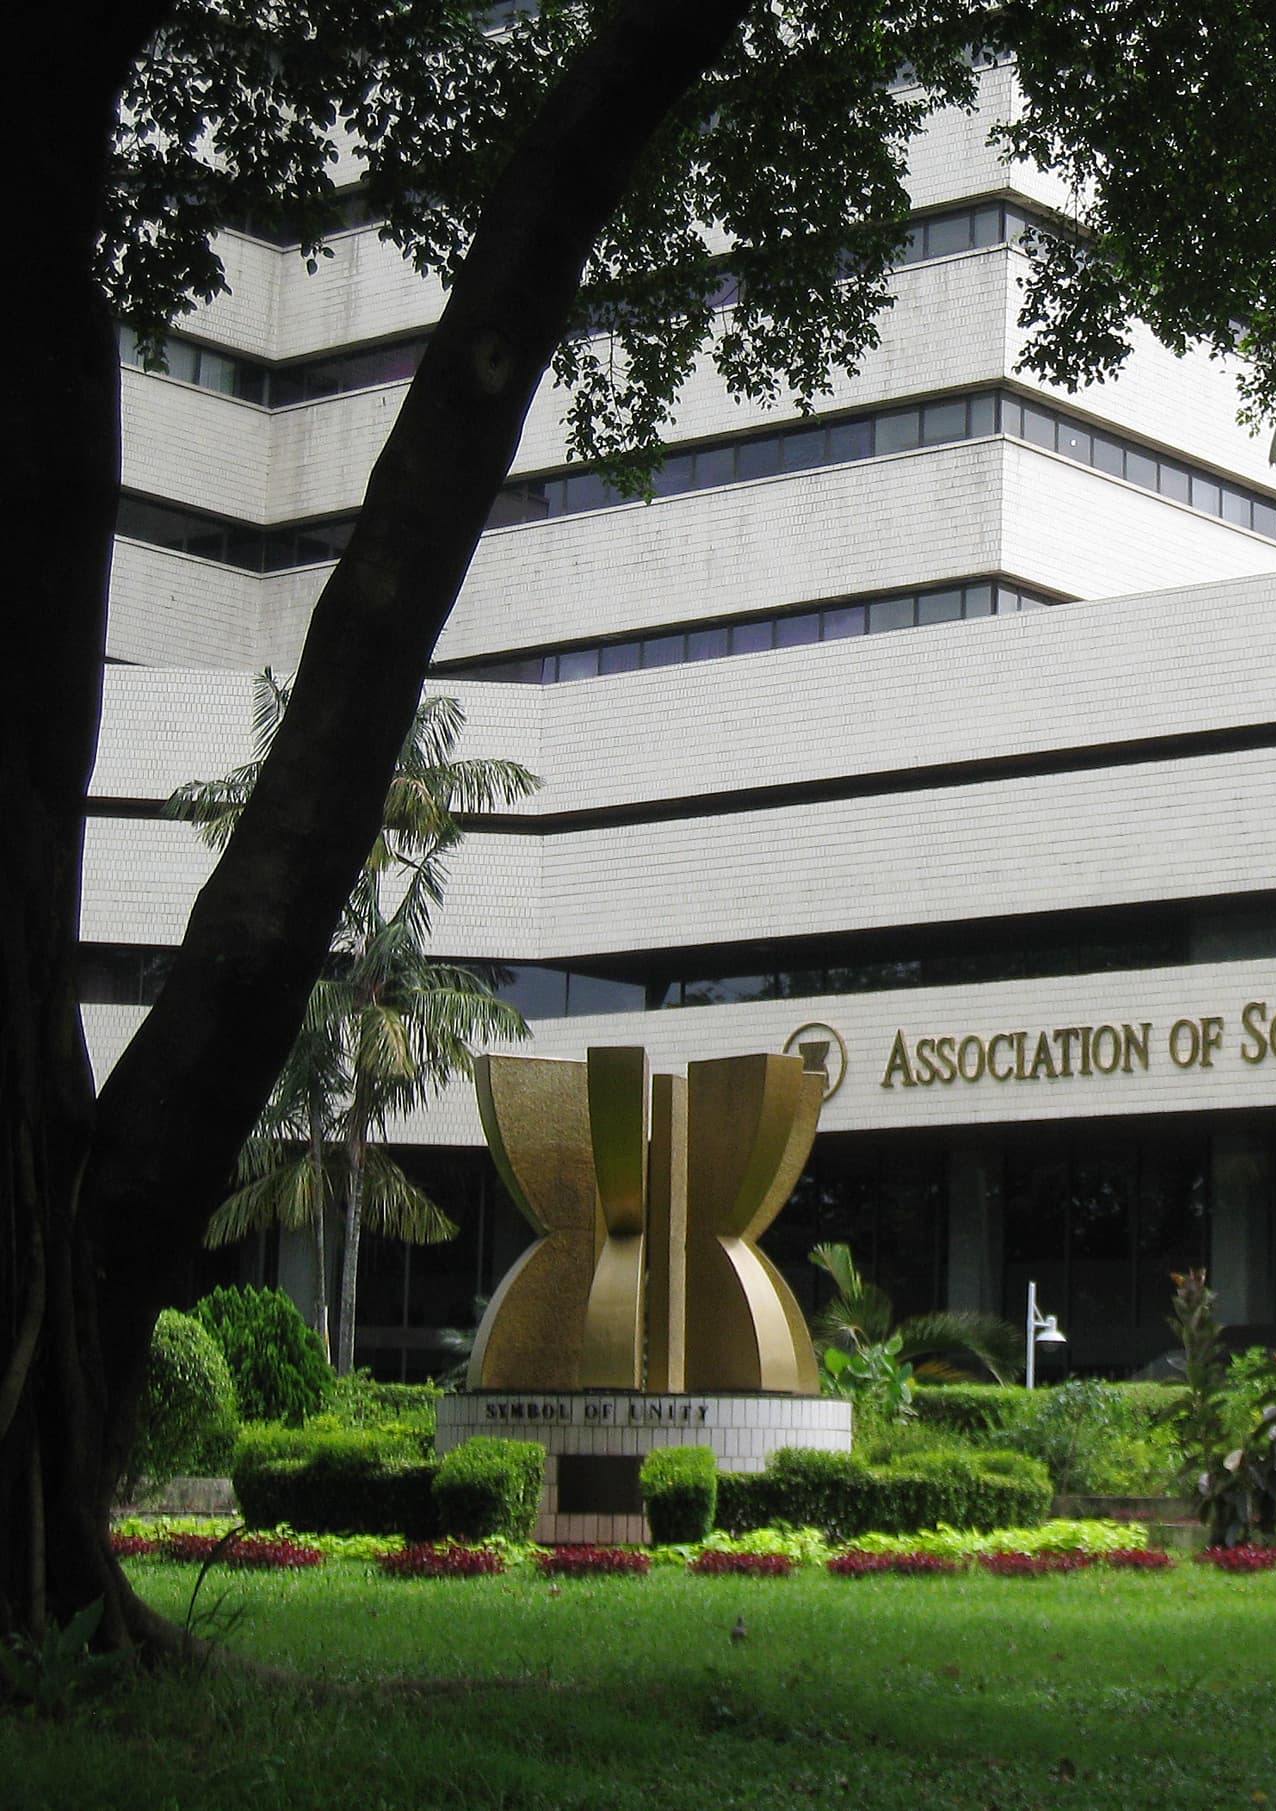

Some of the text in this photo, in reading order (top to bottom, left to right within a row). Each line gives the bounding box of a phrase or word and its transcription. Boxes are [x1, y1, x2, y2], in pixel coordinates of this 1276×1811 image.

[880, 1022, 1152, 1089] ASSOCIATION
[1168, 1016, 1224, 1068] OF
[486, 1403, 708, 1421] SYMBOL OF UNITY
